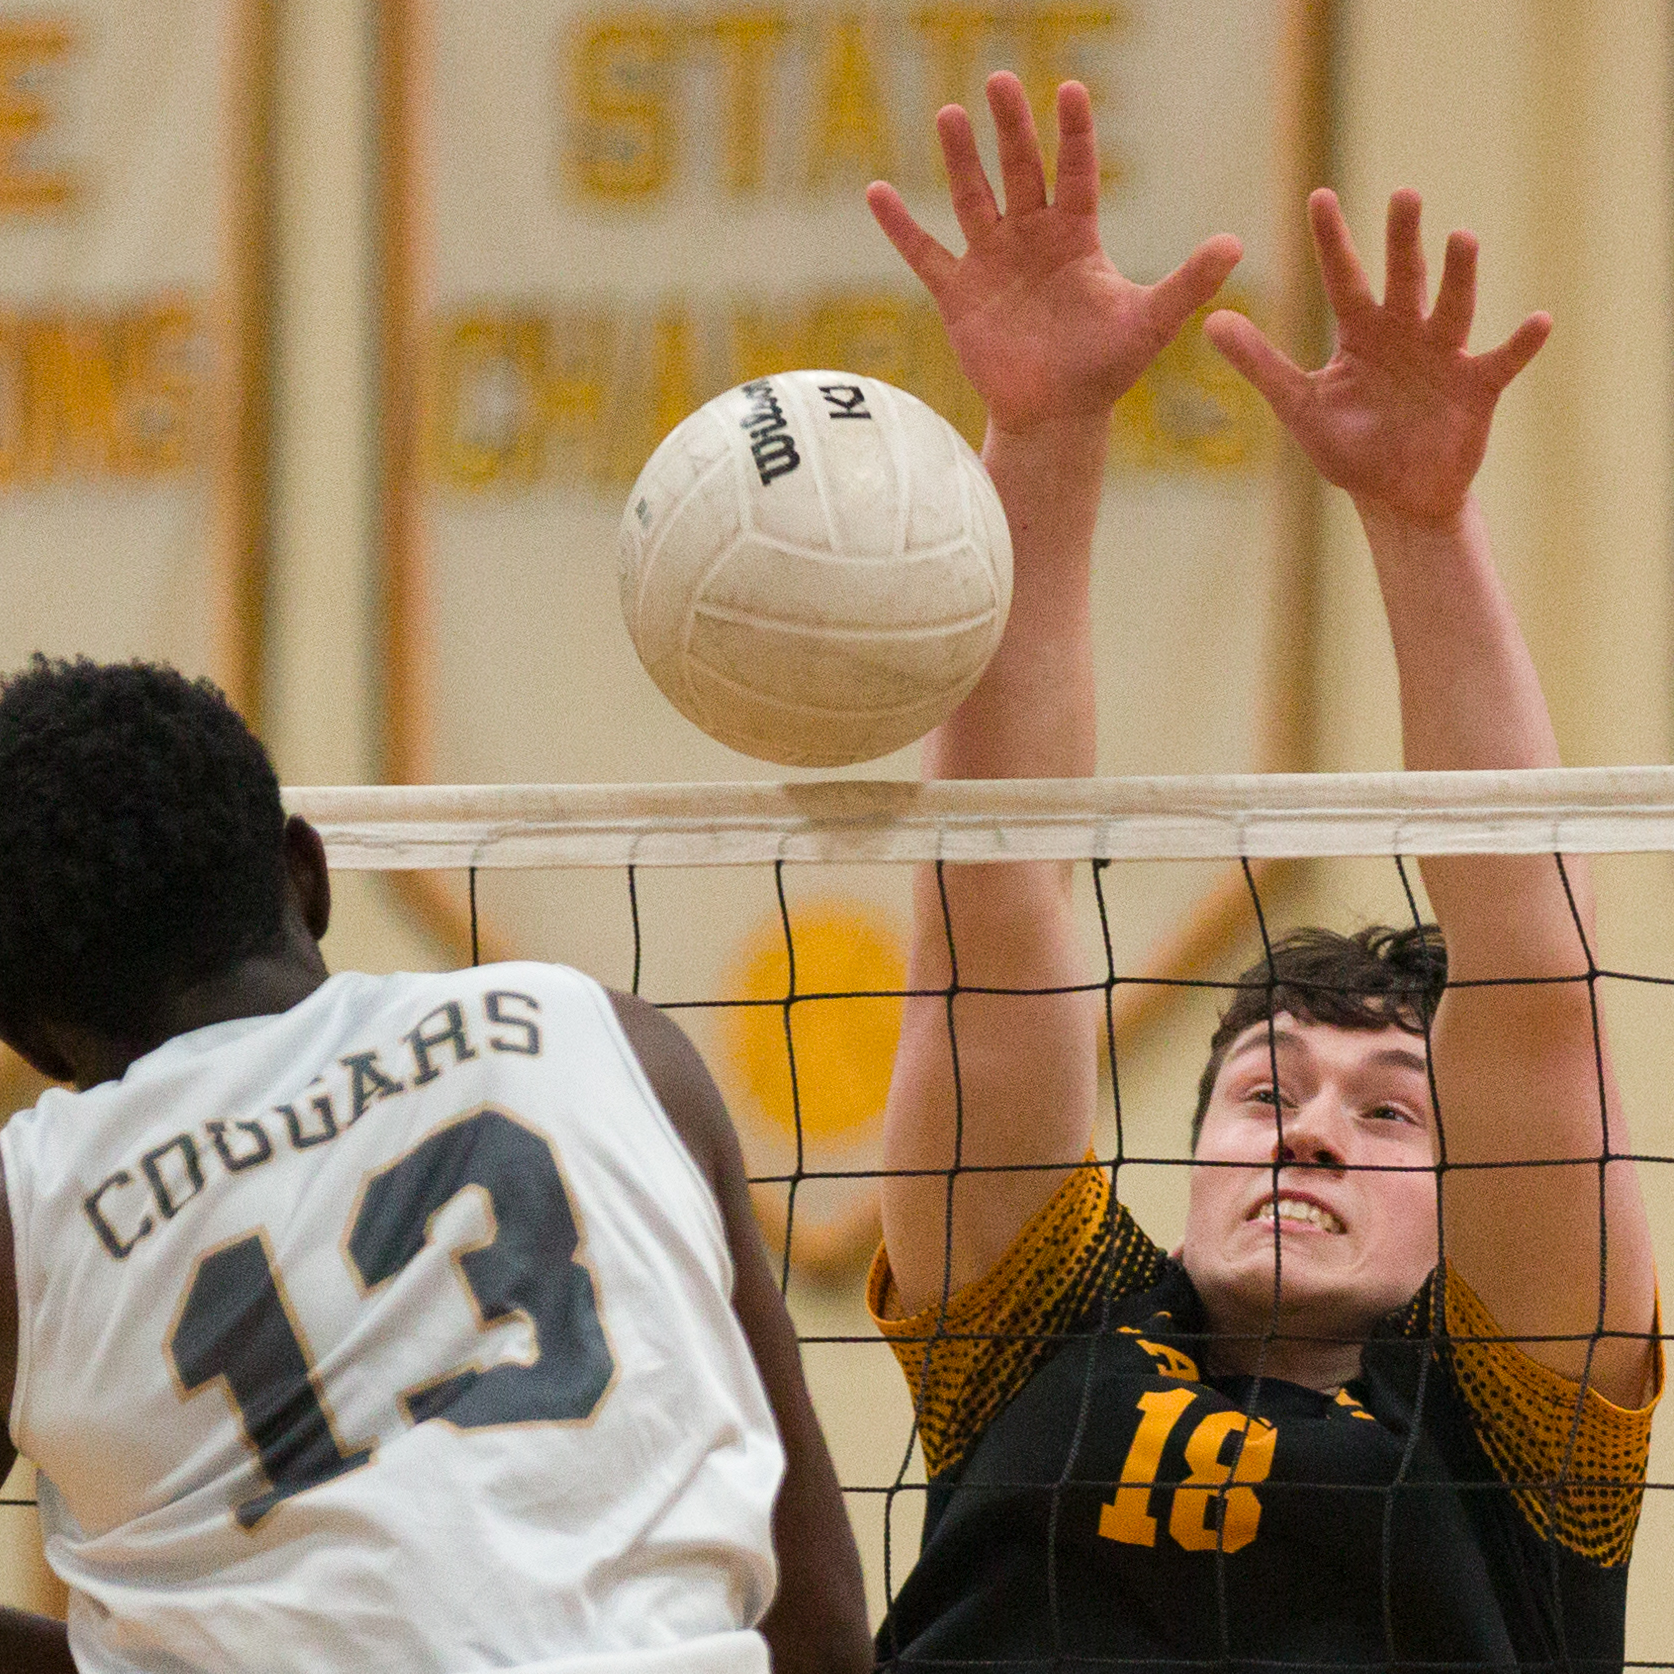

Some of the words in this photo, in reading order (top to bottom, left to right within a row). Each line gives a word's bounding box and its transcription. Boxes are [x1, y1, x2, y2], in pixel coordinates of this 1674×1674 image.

[81, 989, 545, 1260] COUGARS
[161, 1100, 620, 1537] 13
[1098, 1387, 1278, 1554] 18
